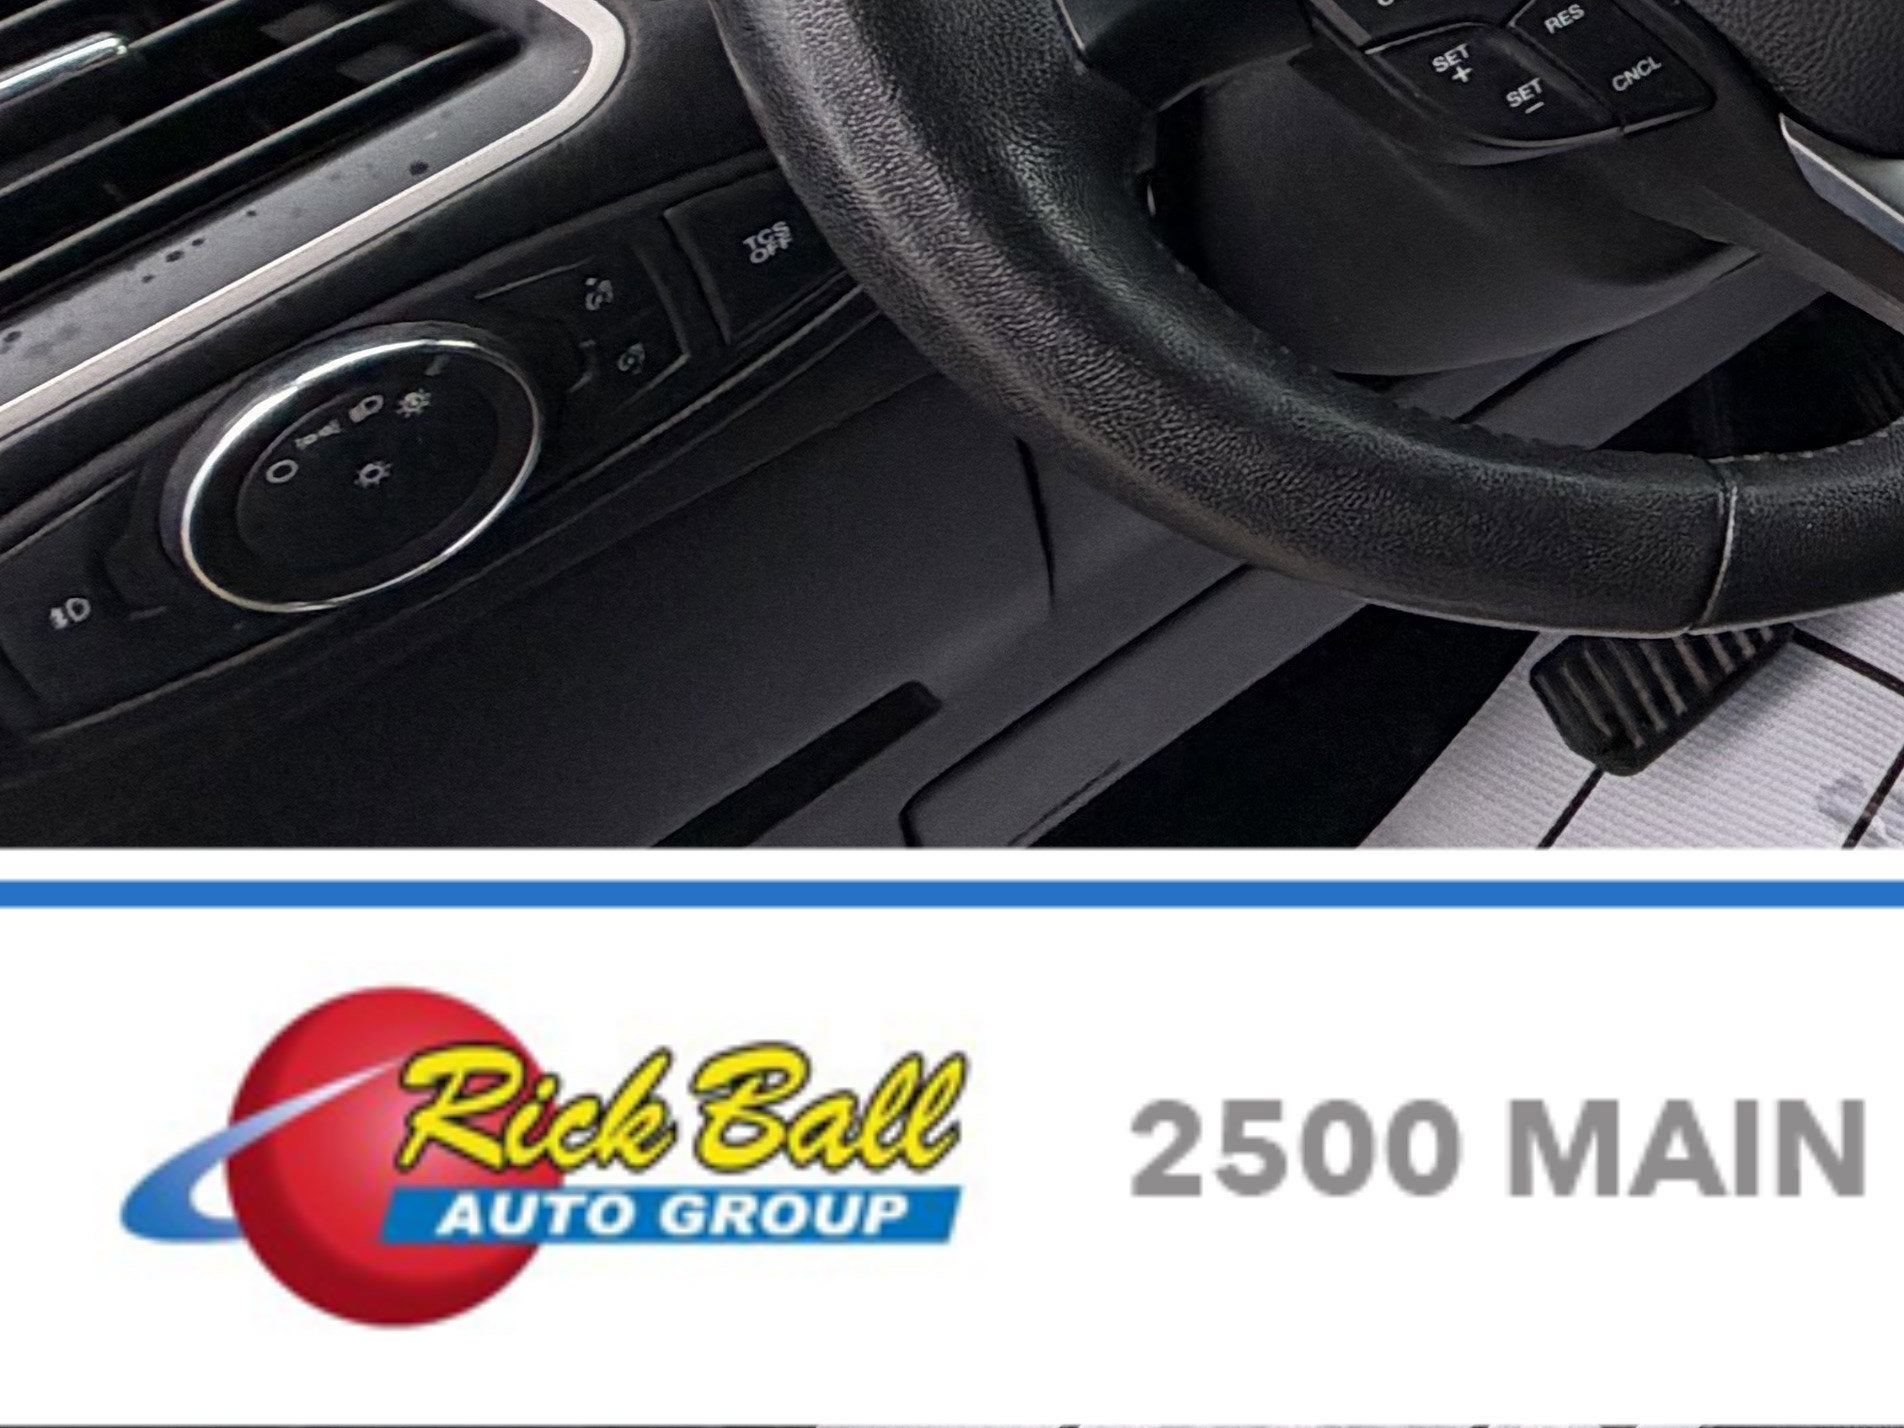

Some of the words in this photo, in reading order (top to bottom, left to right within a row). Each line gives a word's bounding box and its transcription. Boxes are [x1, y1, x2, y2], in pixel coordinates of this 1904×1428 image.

[1544, 4, 1585, 34] RES
[1432, 44, 1470, 74] SET
[1611, 56, 1662, 93] CNCL
[1506, 77, 1544, 109] SET
